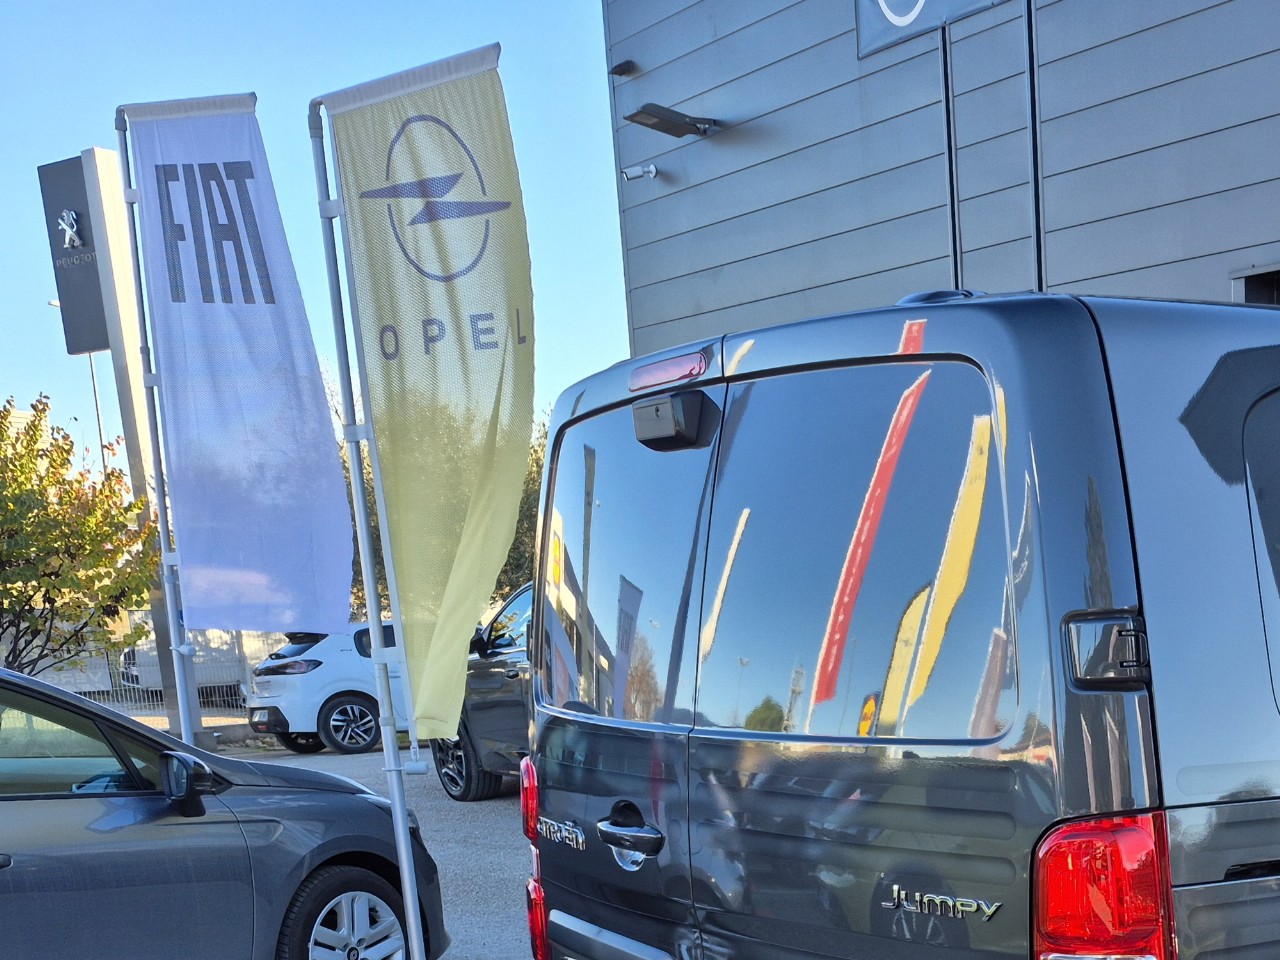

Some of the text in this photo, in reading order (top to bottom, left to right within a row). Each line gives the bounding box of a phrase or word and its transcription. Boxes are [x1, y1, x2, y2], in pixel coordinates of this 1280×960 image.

[154, 160, 276, 304] FIAT
[55, 251, 97, 268] PEUGEOT
[379, 308, 526, 361] OPEL
